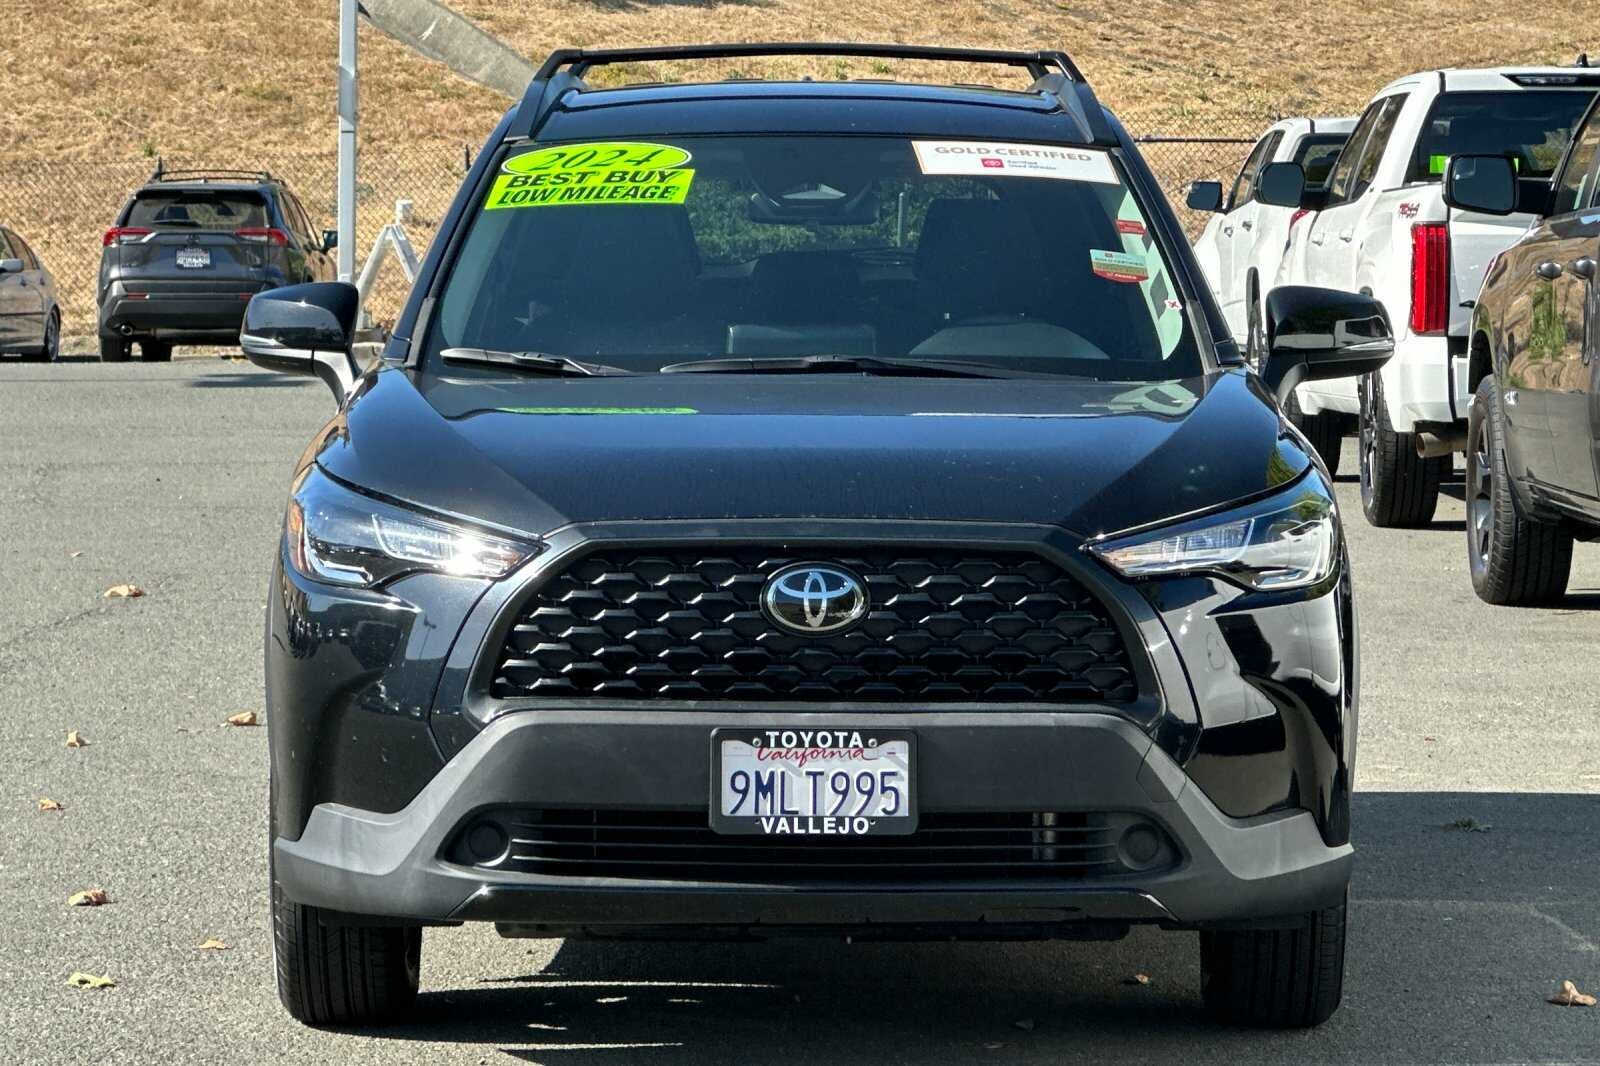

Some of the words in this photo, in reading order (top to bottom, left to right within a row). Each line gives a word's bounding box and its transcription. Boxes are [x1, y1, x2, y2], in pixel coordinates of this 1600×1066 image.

[527, 149, 667, 171] 2024
[935, 146, 990, 155] GOLD
[995, 148, 1092, 161] CERTIFIED
[505, 170, 598, 188] BEST
[603, 169, 683, 183] BUY
[497, 187, 561, 205] LOW
[559, 185, 680, 201] MILEAGE
[766, 731, 863, 748] TOYOTA
[730, 771, 900, 815] 9MLT995
[761, 817, 869, 834] VALLEJO
